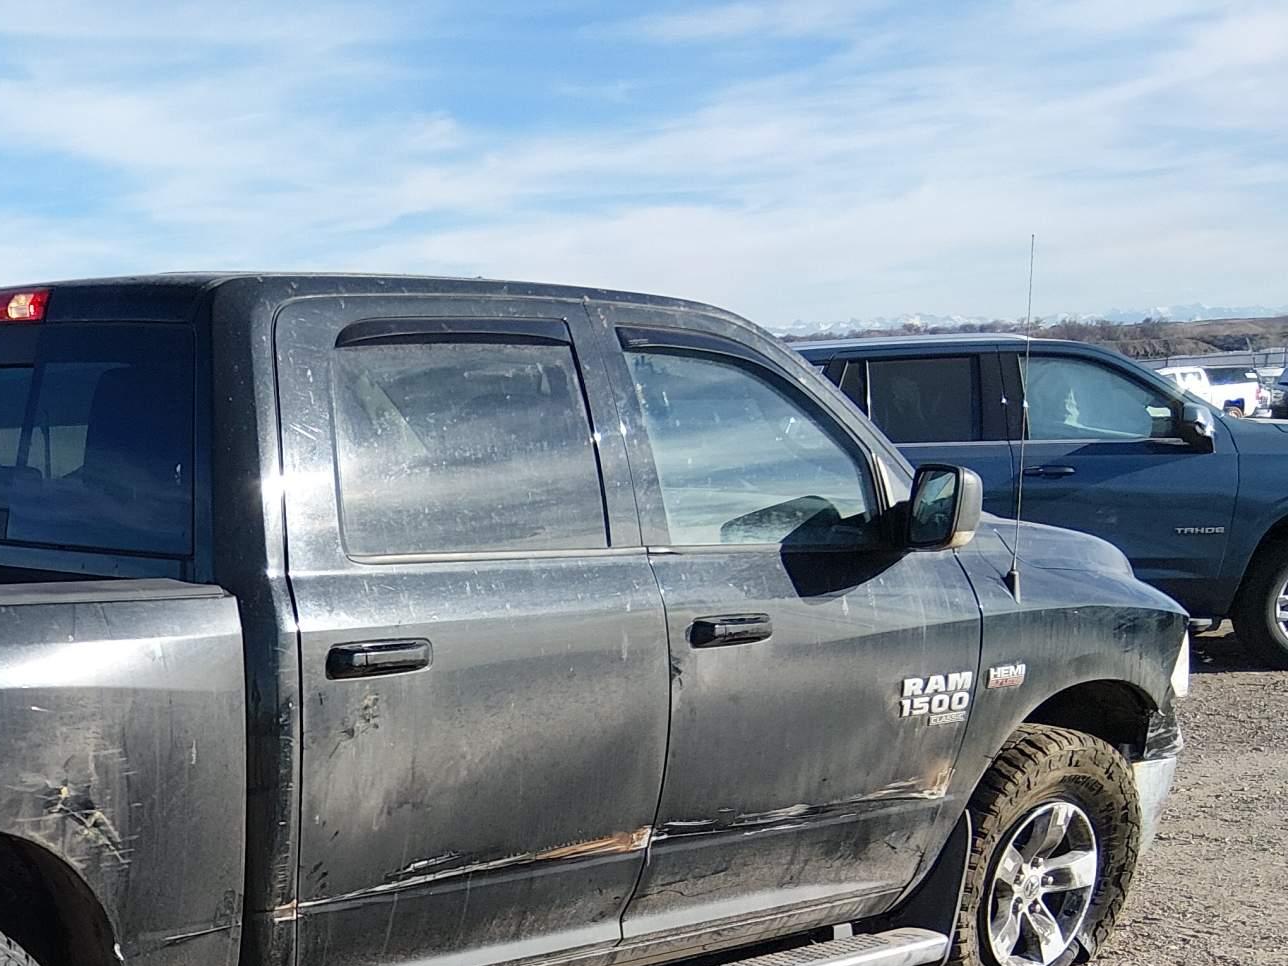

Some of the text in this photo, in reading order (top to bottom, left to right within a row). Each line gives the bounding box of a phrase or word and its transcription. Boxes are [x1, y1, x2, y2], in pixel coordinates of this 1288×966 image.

[1175, 526, 1225, 535] TAHOE
[989, 663, 1026, 679] HEMI
[902, 671, 973, 697] RAM
[900, 691, 970, 717] 1500
